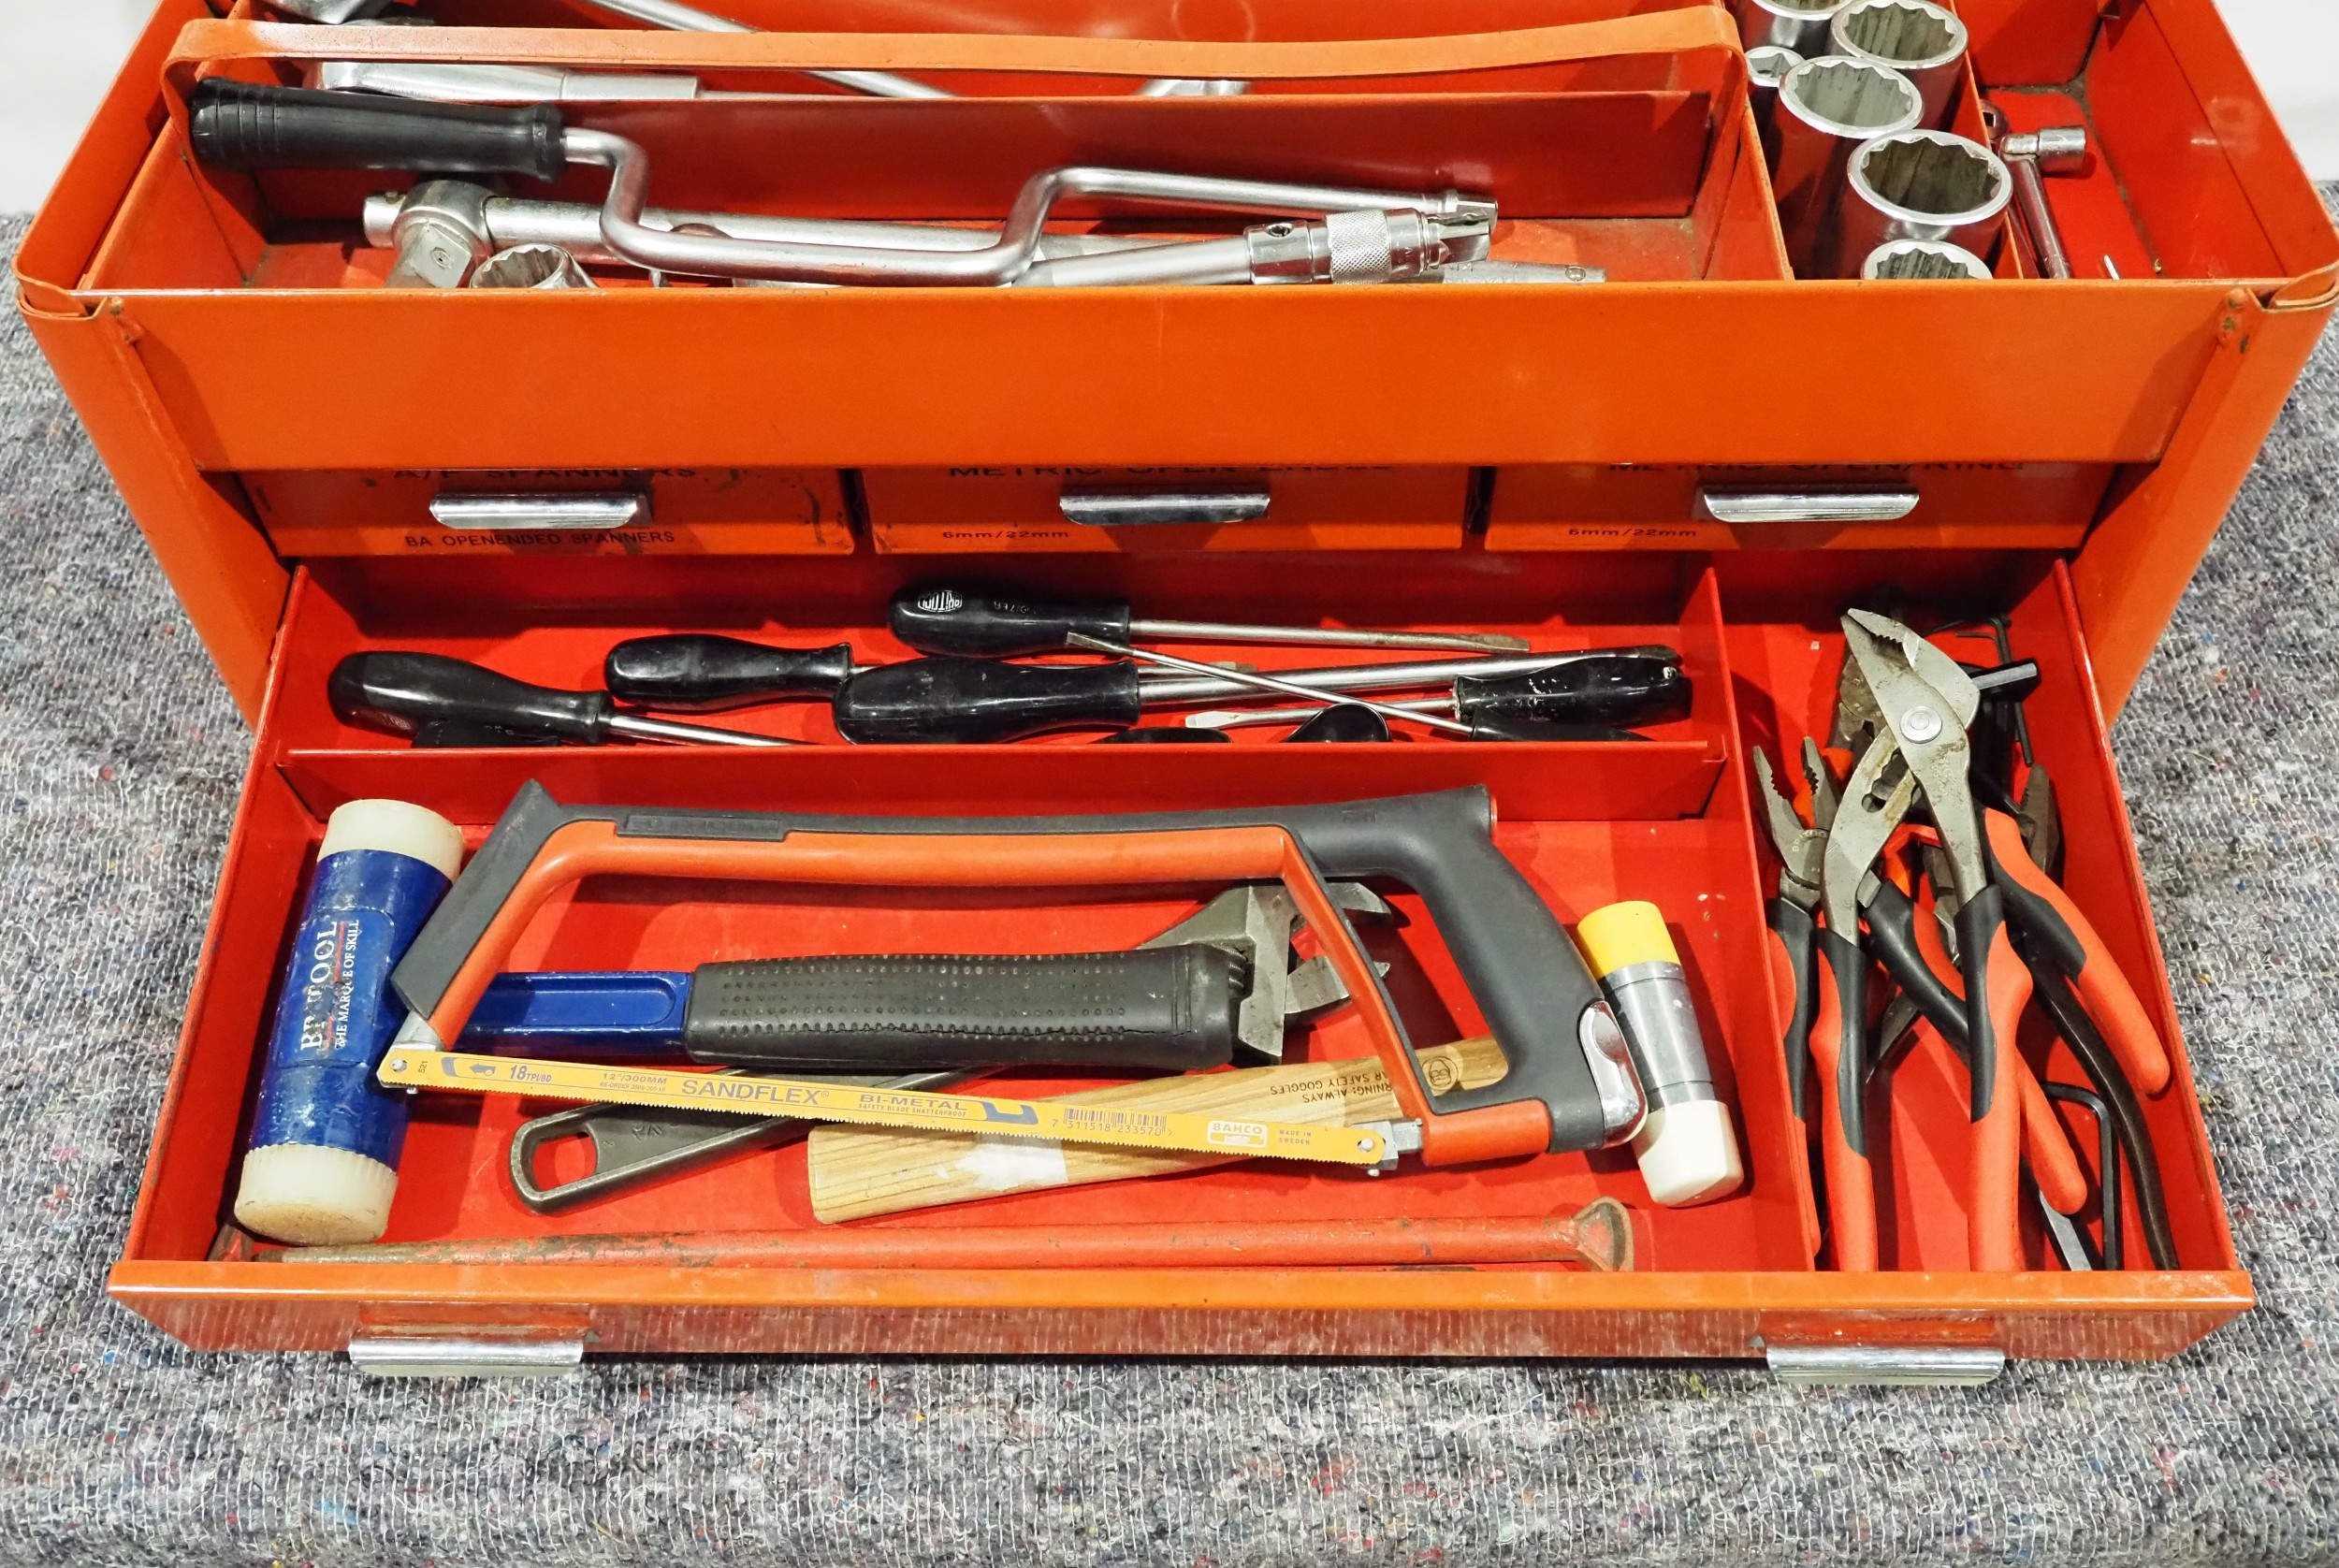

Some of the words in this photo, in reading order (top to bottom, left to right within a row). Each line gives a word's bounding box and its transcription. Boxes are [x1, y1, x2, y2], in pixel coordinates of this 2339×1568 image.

[404, 535, 433, 547] BA
[572, 531, 676, 546] SPANNERS
[942, 530, 1069, 540] 6mm/22mm
[1568, 528, 1697, 537] 6mm/22mm
[345, 920, 359, 951] SKILL
[343, 954, 356, 968] OF
[300, 921, 338, 1052] BRTOOL
[1328, 1073, 1370, 1088] SAFETY
[1270, 1080, 1323, 1096] GOGGLES
[1352, 1082, 1392, 1096] RNING:
[860, 1094, 967, 1111] BI-METAL
[1301, 1087, 1347, 1104] ALWAYS
[859, 1102, 884, 1111] SAFETY
[887, 1105, 909, 1113] BLADE
[1212, 1122, 1263, 1135] BAHCO
[1279, 1129, 1301, 1138] MADE
[1278, 1137, 1311, 1145] SWEDEN
